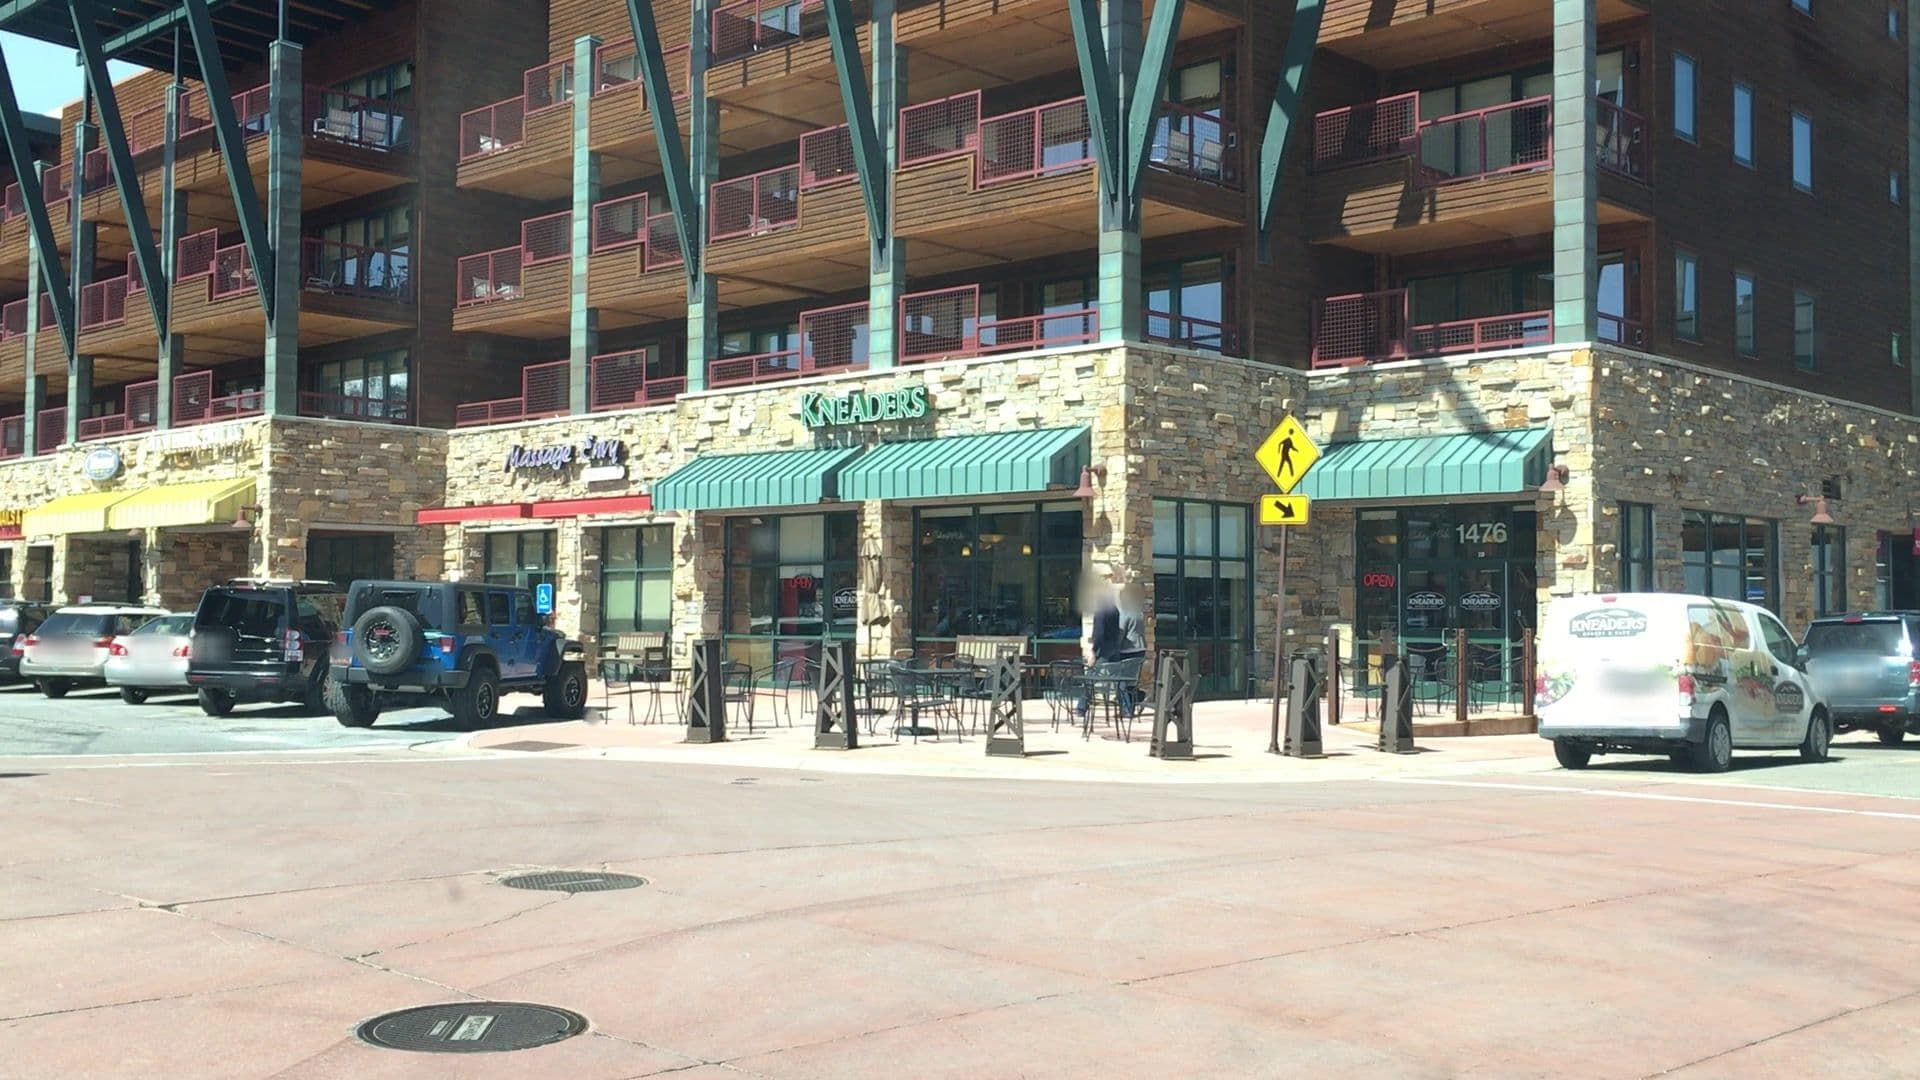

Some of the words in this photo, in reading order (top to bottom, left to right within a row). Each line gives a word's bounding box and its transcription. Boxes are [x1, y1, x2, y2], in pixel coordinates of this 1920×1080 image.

[800, 387, 926, 427] KNEADERS
[507, 443, 572, 470] Massage
[581, 436, 620, 464] Envy
[1456, 522, 1507, 544] 1476
[1363, 574, 1395, 588] OPEN
[1408, 598, 1444, 606] KNEADERS
[1462, 598, 1500, 606] KNEADERS
[1572, 617, 1646, 632] KNEADERS
